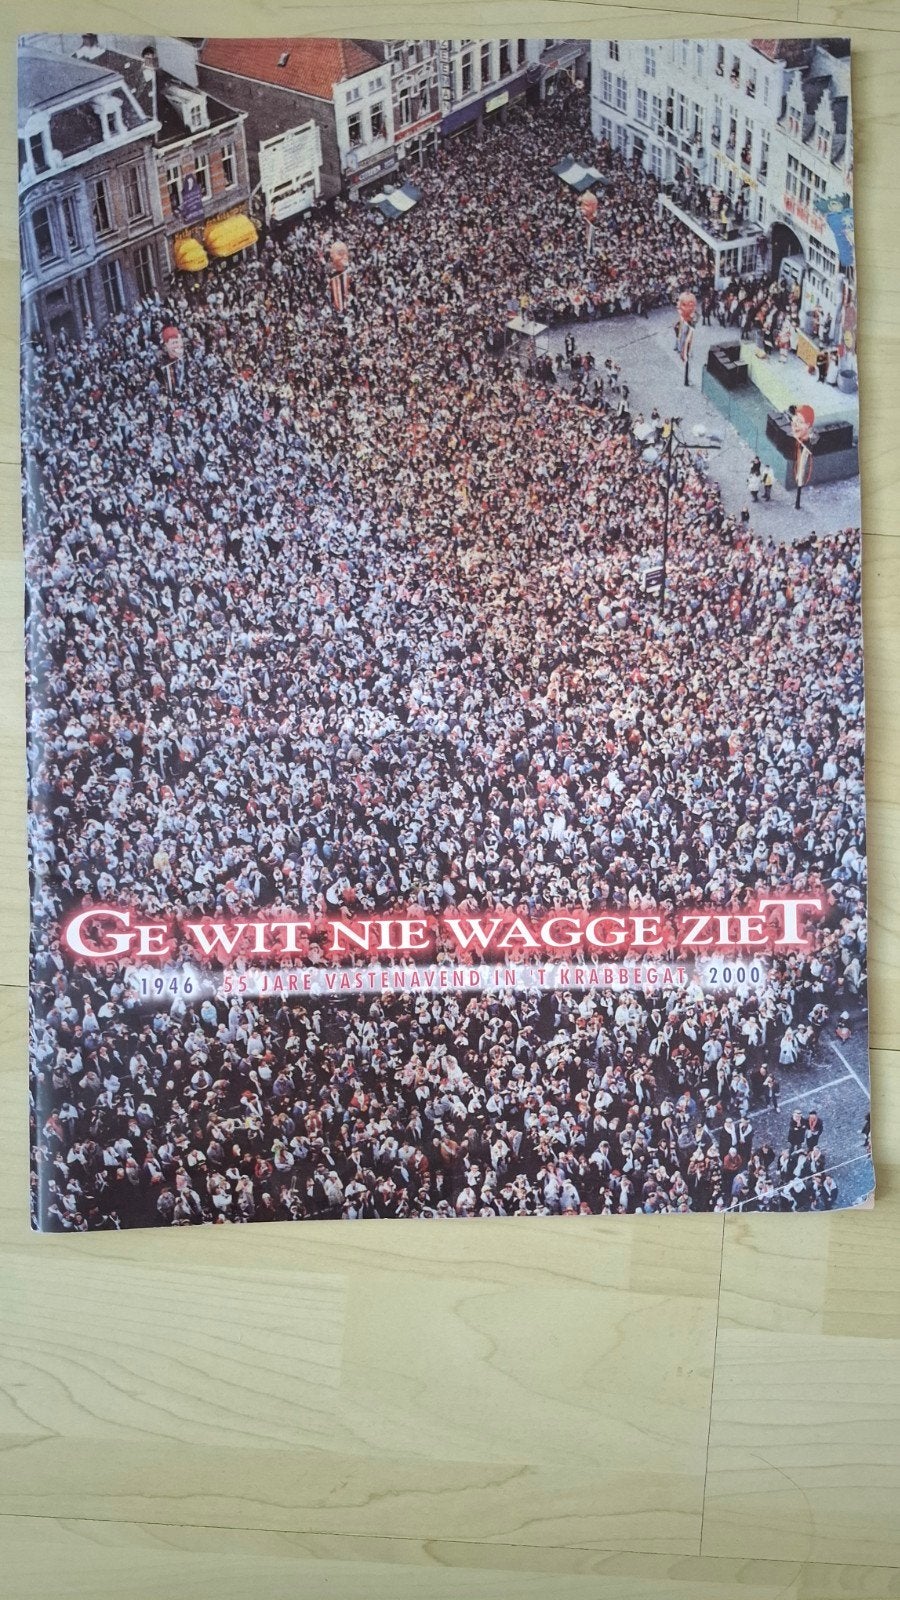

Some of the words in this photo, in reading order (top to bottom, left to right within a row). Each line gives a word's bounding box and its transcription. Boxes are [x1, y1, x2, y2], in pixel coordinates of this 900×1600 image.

[66, 909, 168, 957] GE
[187, 922, 312, 953] WIT
[328, 919, 432, 951] NIE
[444, 915, 664, 949] WAGGE
[681, 898, 822, 946] ZIET
[140, 977, 195, 995] 1946
[223, 976, 249, 993] 55
[262, 974, 312, 992] JARE
[325, 970, 481, 990] VASTENAVEND
[494, 969, 516, 986] IN
[560, 967, 686, 985] KRABBEGAT
[709, 966, 761, 985] 2000
